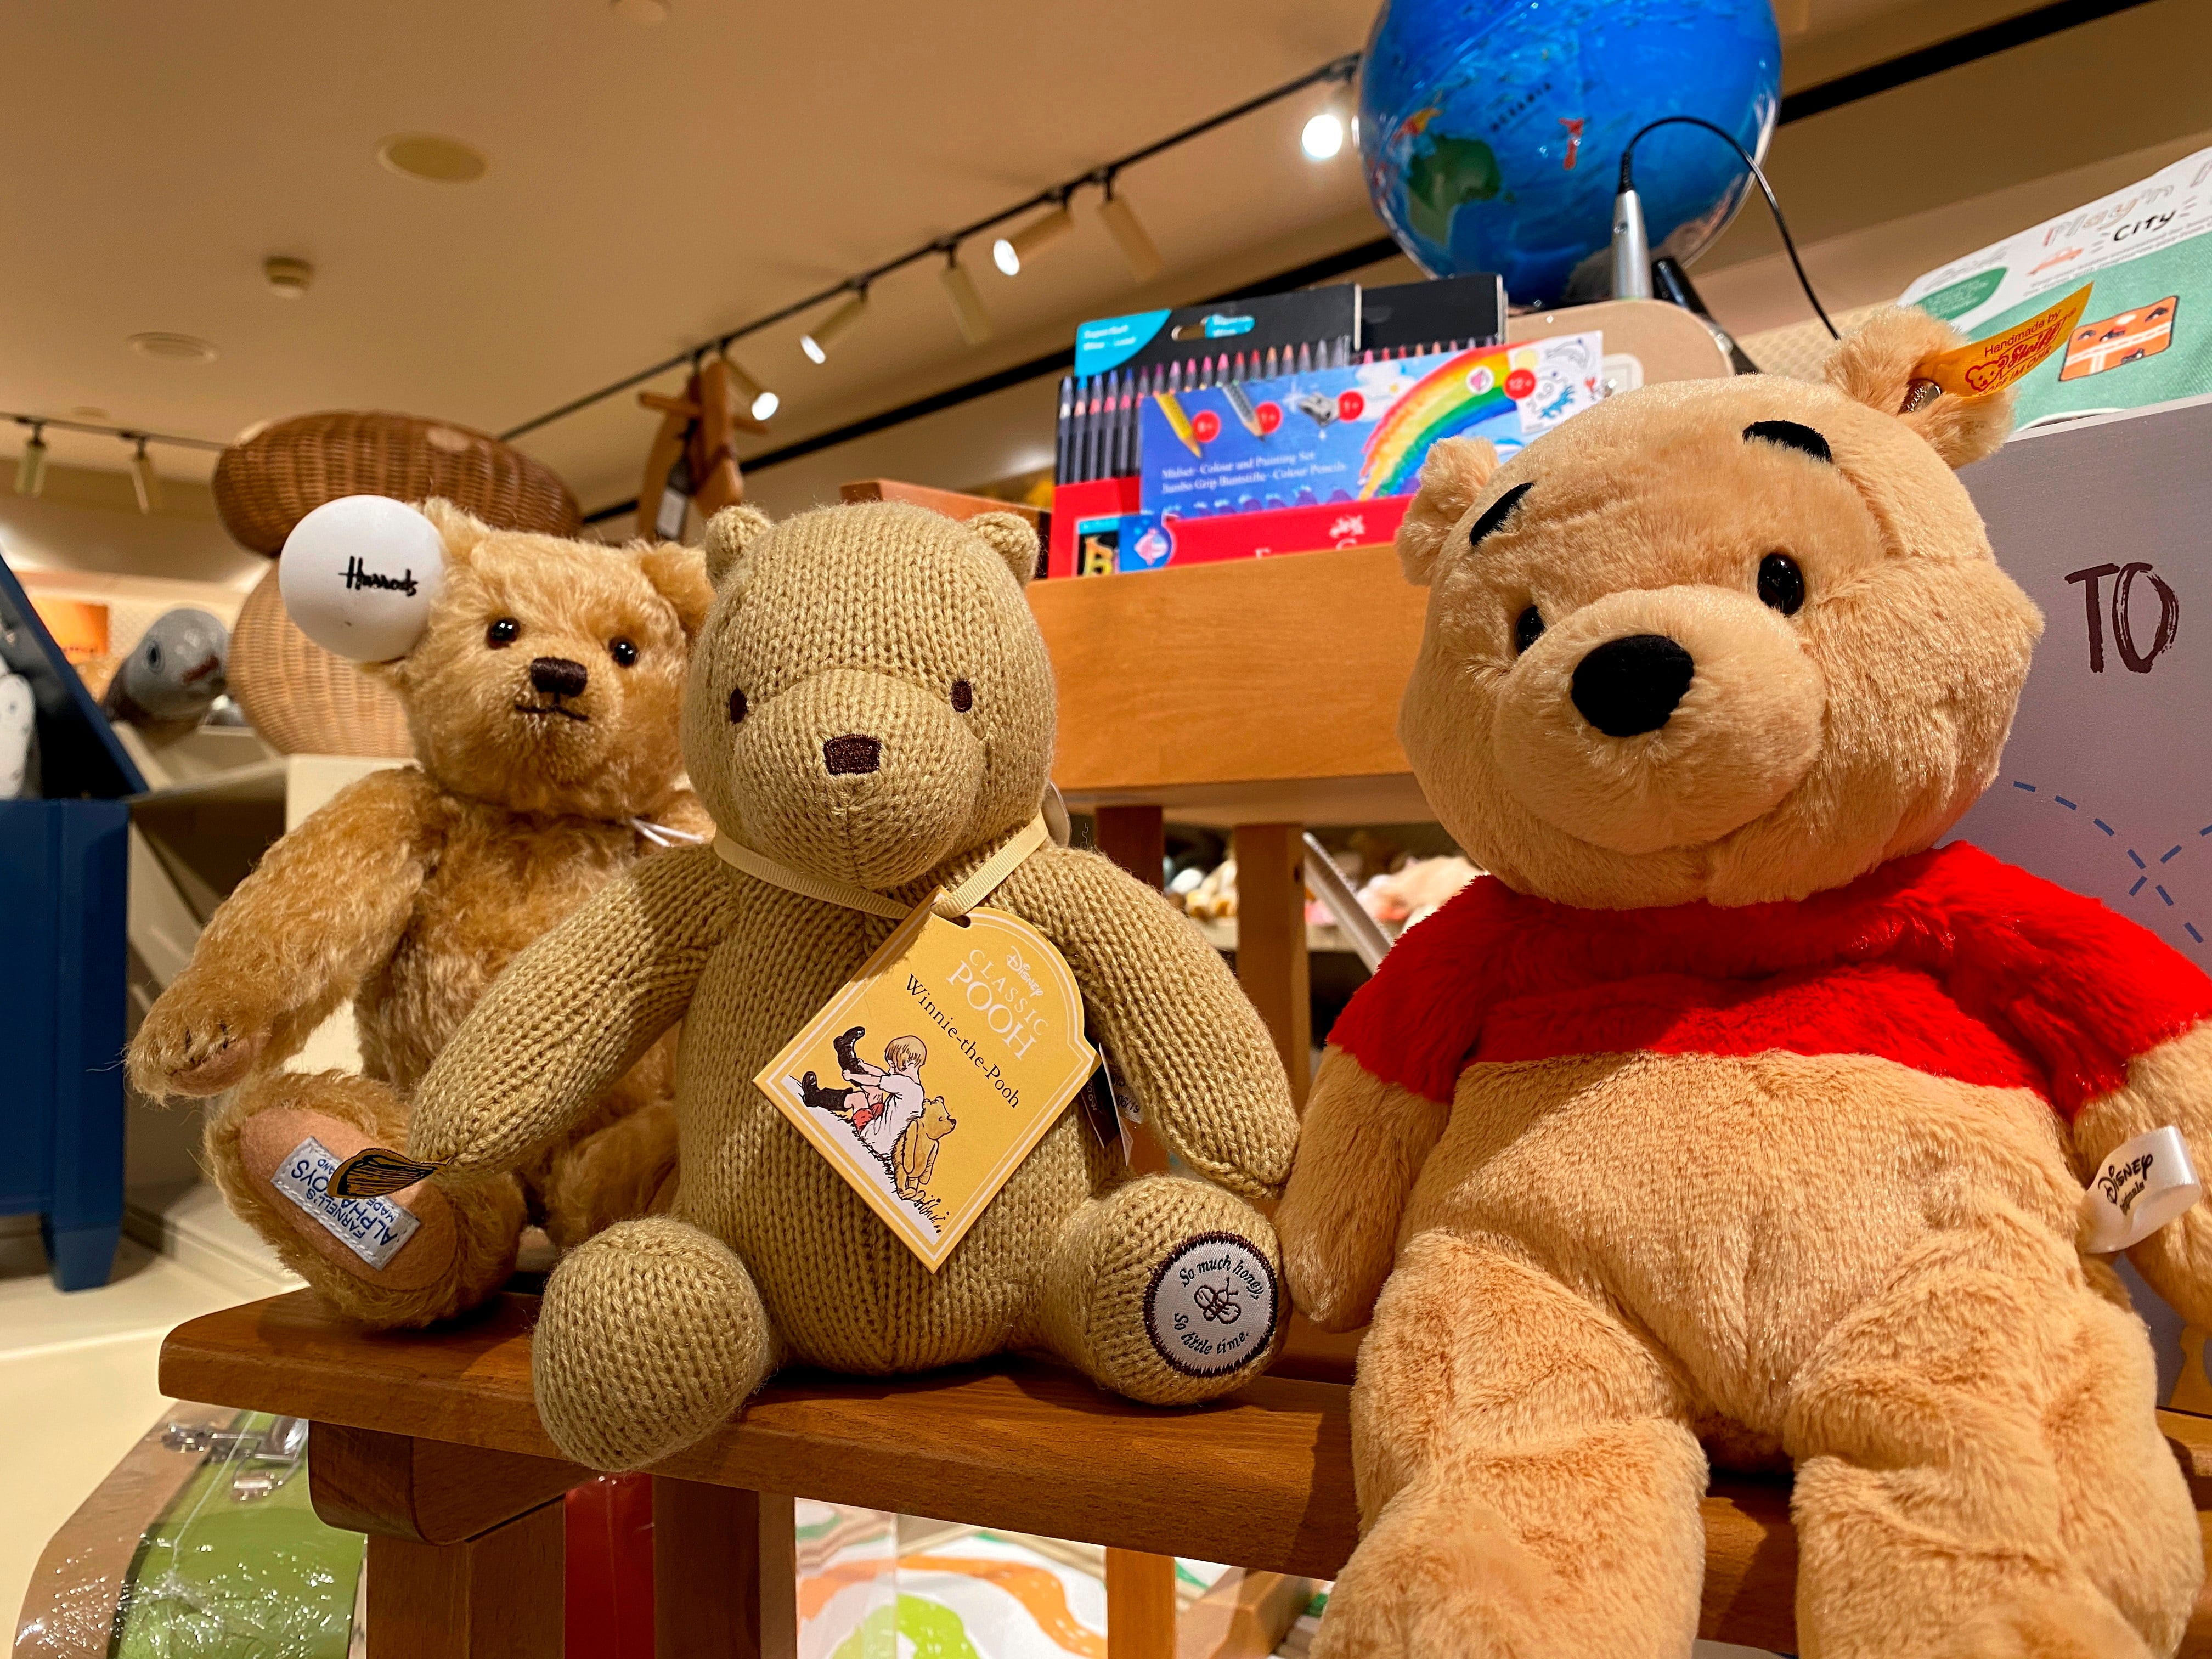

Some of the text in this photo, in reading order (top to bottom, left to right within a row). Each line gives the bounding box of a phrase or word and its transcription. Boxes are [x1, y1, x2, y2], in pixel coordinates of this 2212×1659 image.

[1984, 309, 2061, 357] Handmade by
[338, 555, 418, 596] Harrods
[969, 949, 1048, 1036] CLASSIC
[1006, 945, 1043, 997] Disney
[946, 960, 1037, 1061] POOH
[906, 973, 1020, 1109] Winnie-the-Pooh
[2097, 1154, 2153, 1205] Disney
[306, 1188, 365, 1239] FARNELL'S
[341, 1199, 398, 1246] ALPHA
[366, 1198, 396, 1223] MADE
[1179, 1266, 1195, 1288] So
[1197, 1254, 1231, 1274] much
[1173, 1312, 1250, 1356] So little time.
